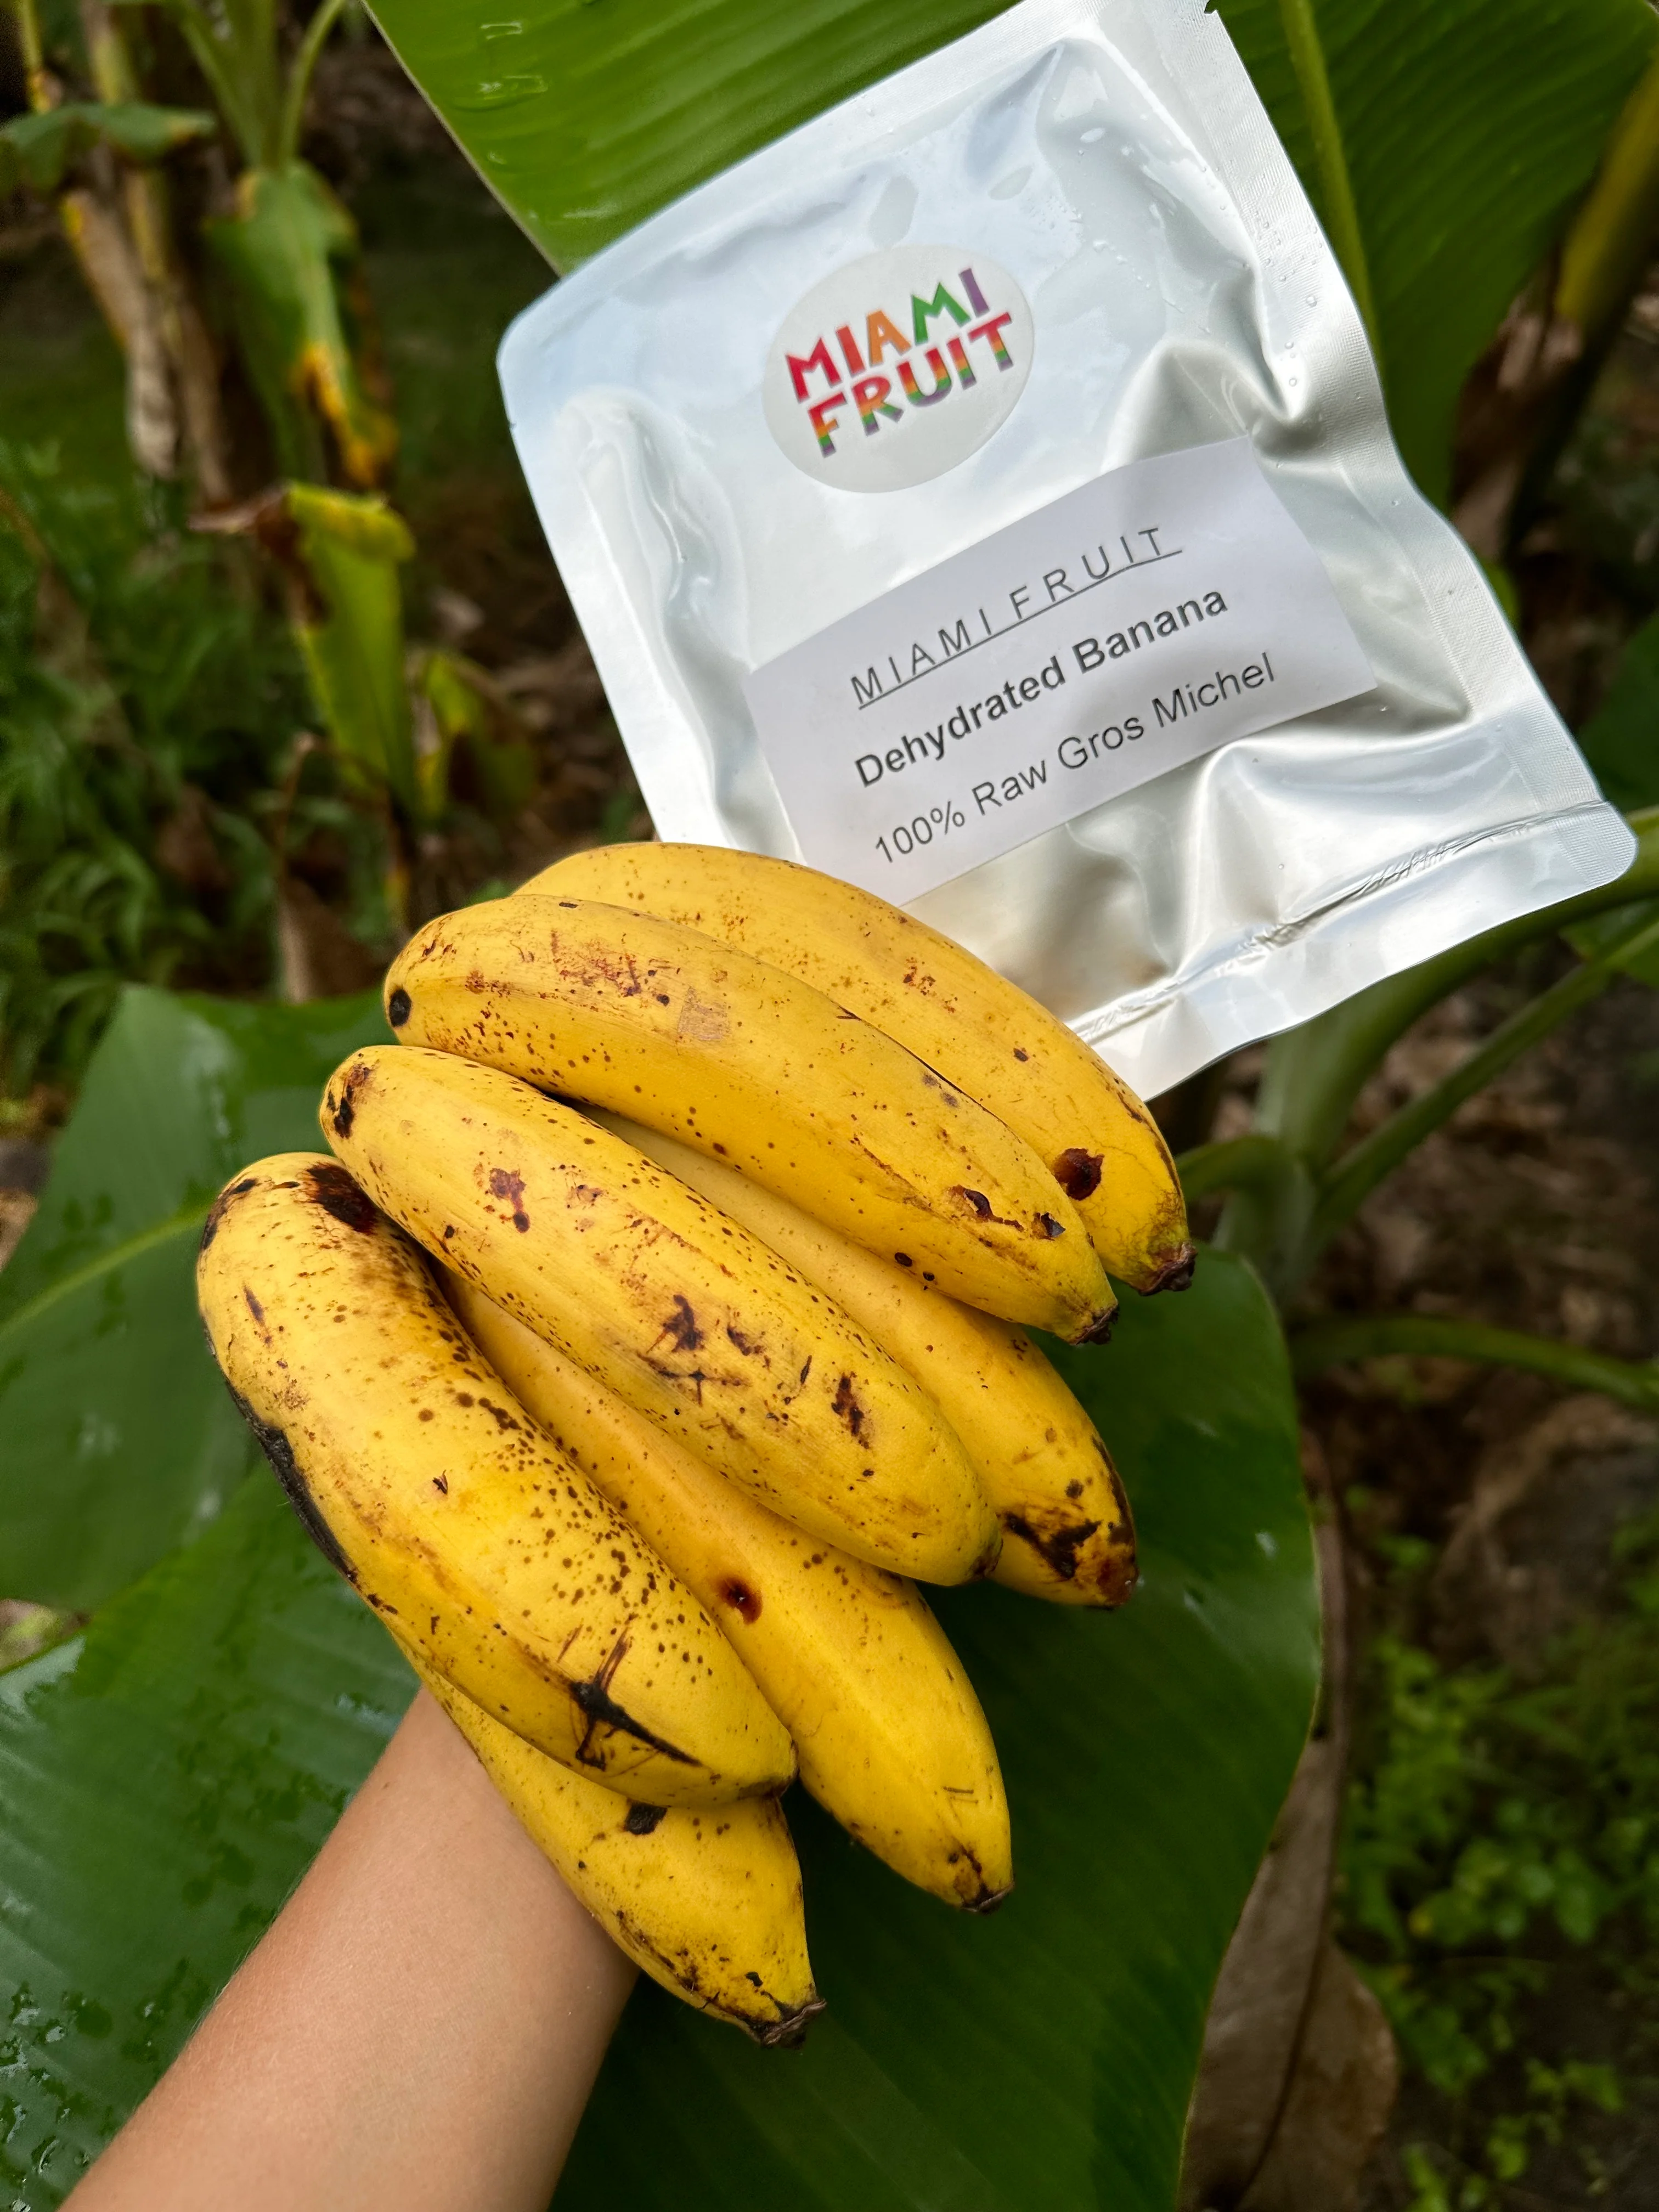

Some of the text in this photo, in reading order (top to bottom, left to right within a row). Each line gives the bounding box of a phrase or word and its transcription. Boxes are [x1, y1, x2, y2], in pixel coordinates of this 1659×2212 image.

[786, 267, 990, 404] MIAMI
[808, 311, 1014, 459] FRUIT
[850, 527, 1163, 705] MIAMI FRUIT
[854, 590, 1228, 787] Dehydrated Banana
[874, 651, 1276, 864] 100% Raw Gros Michel
